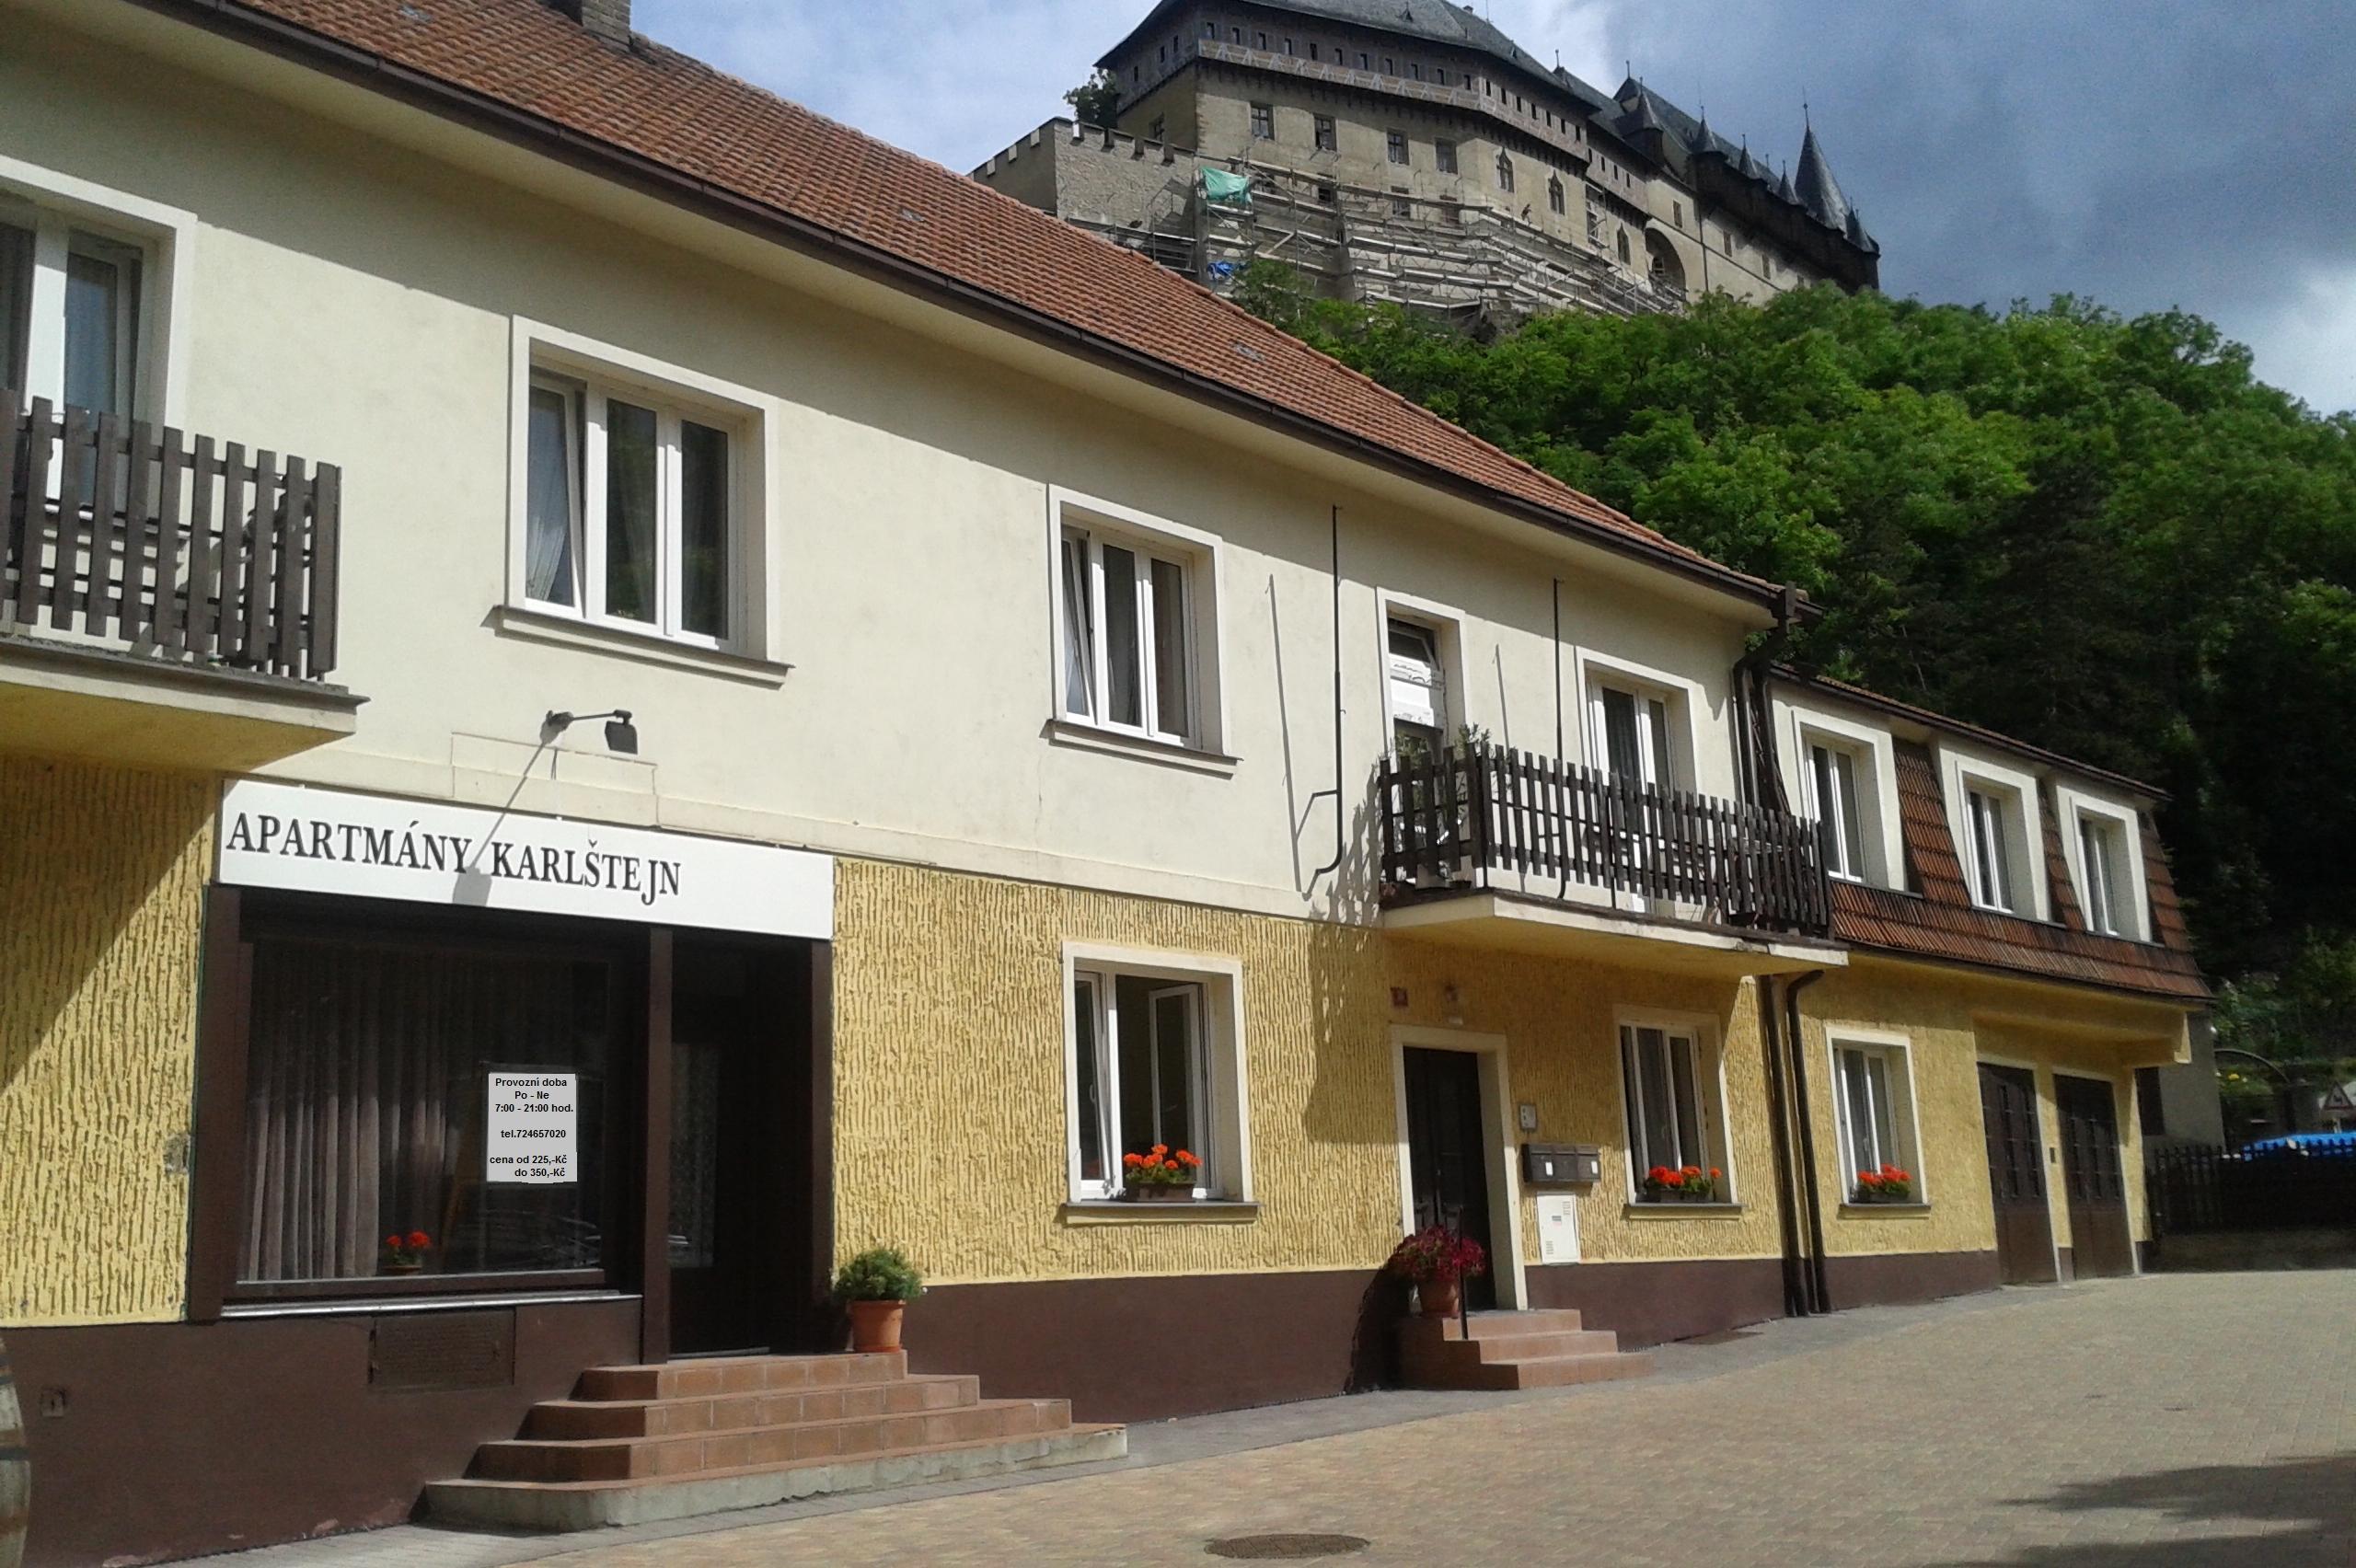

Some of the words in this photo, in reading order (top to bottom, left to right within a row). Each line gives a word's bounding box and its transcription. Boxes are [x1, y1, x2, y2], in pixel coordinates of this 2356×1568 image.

[225, 811, 471, 875] APARTMÁNY
[491, 840, 681, 905] KARLŠTEJN
[495, 1078, 539, 1087] Provozní
[542, 1078, 567, 1087] doba
[514, 1091, 527, 1100] Po
[537, 1091, 549, 1100] Ne
[495, 1103, 514, 1113] 7:00
[524, 1103, 549, 1113] 21:00
[551, 1103, 573, 1113] hod.
[501, 1129, 566, 1138] tel.724657020
[516, 1155, 529, 1164] od
[532, 1154, 567, 1165] 225,-Kč
[514, 1168, 527, 1177] do
[530, 1168, 565, 1178] 350,-Kč
